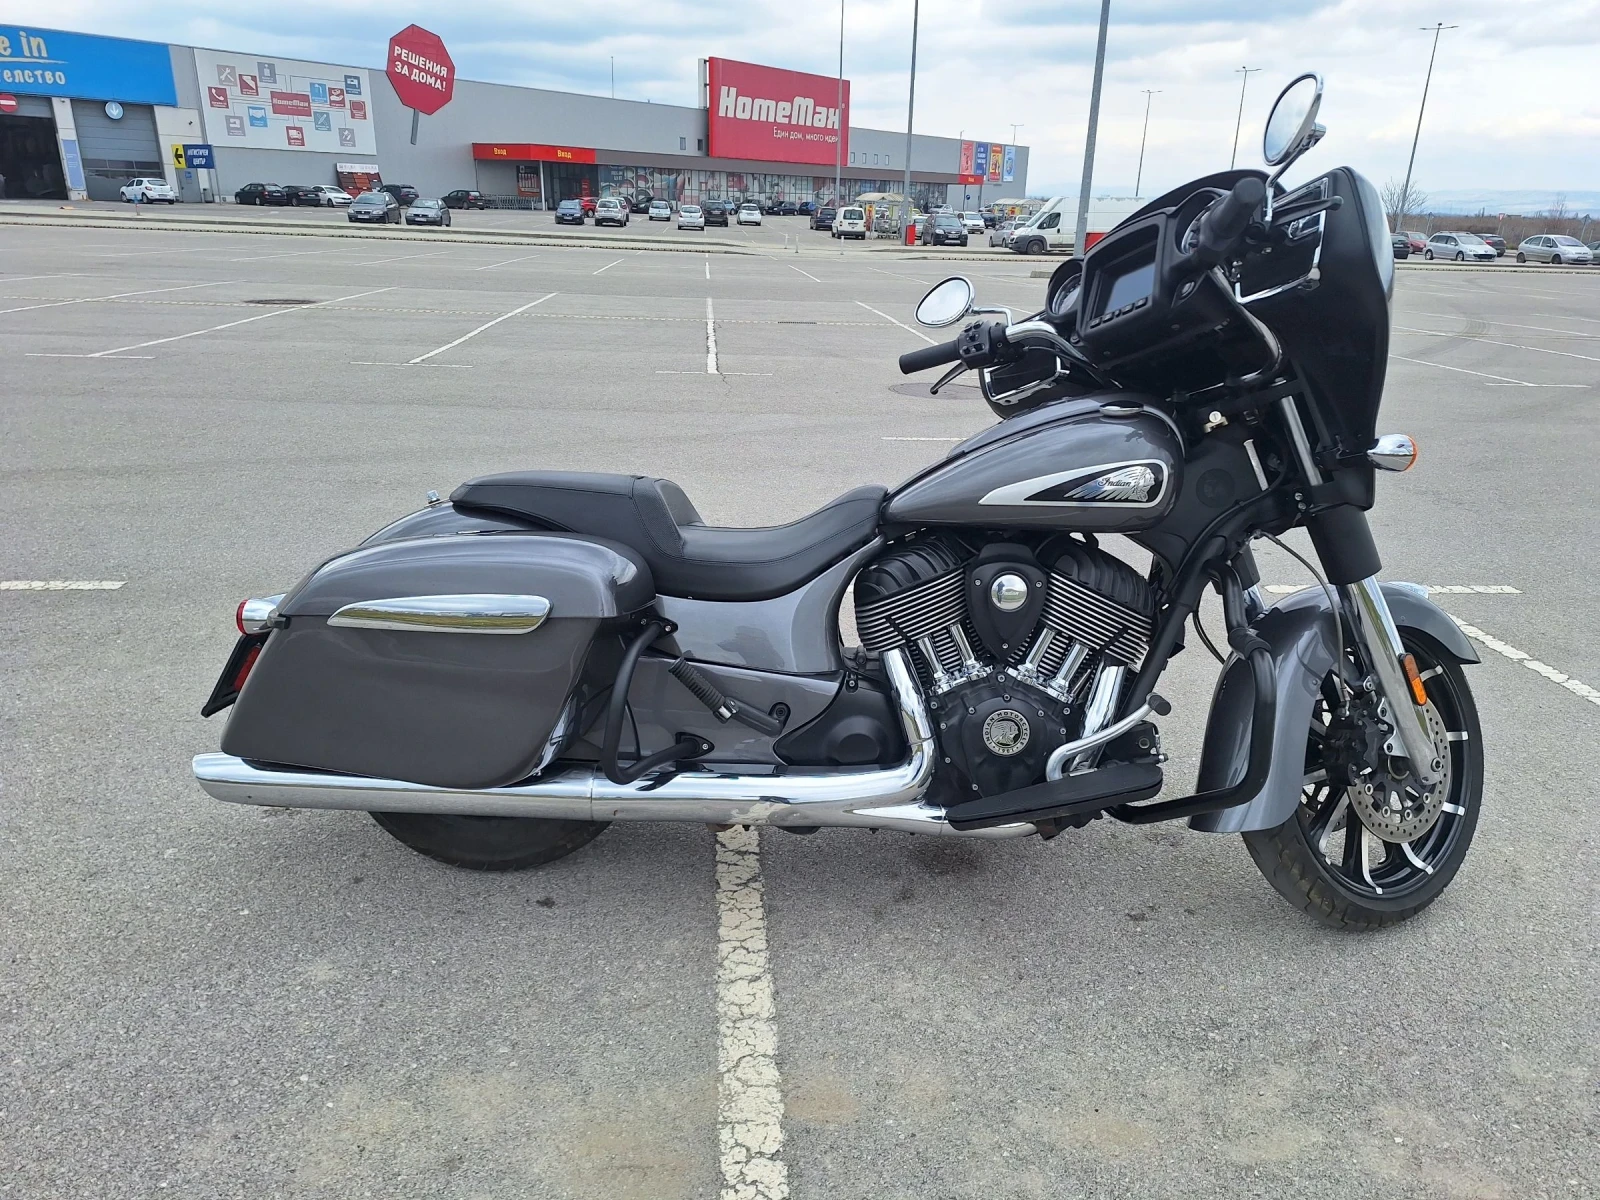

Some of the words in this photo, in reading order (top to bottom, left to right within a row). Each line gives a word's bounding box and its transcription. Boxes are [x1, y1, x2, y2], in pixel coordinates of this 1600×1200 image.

[19, 31, 48, 57] in
[394, 45, 448, 78] РЕШЕНИЯ
[0, 69, 66, 85] елство
[394, 61, 409, 77] ЗА
[410, 68, 447, 92] ДОМА!
[718, 85, 839, 130] HomeMax
[773, 126, 789, 139] Един
[790, 131, 805, 142] дом,
[805, 133, 824, 142] много
[493, 147, 507, 156] Вход
[557, 149, 572, 159] Вход
[1097, 476, 1131, 487] Indian
[984, 716, 995, 745] INDIAN
[996, 711, 1029, 746] MOTORCYCLE
